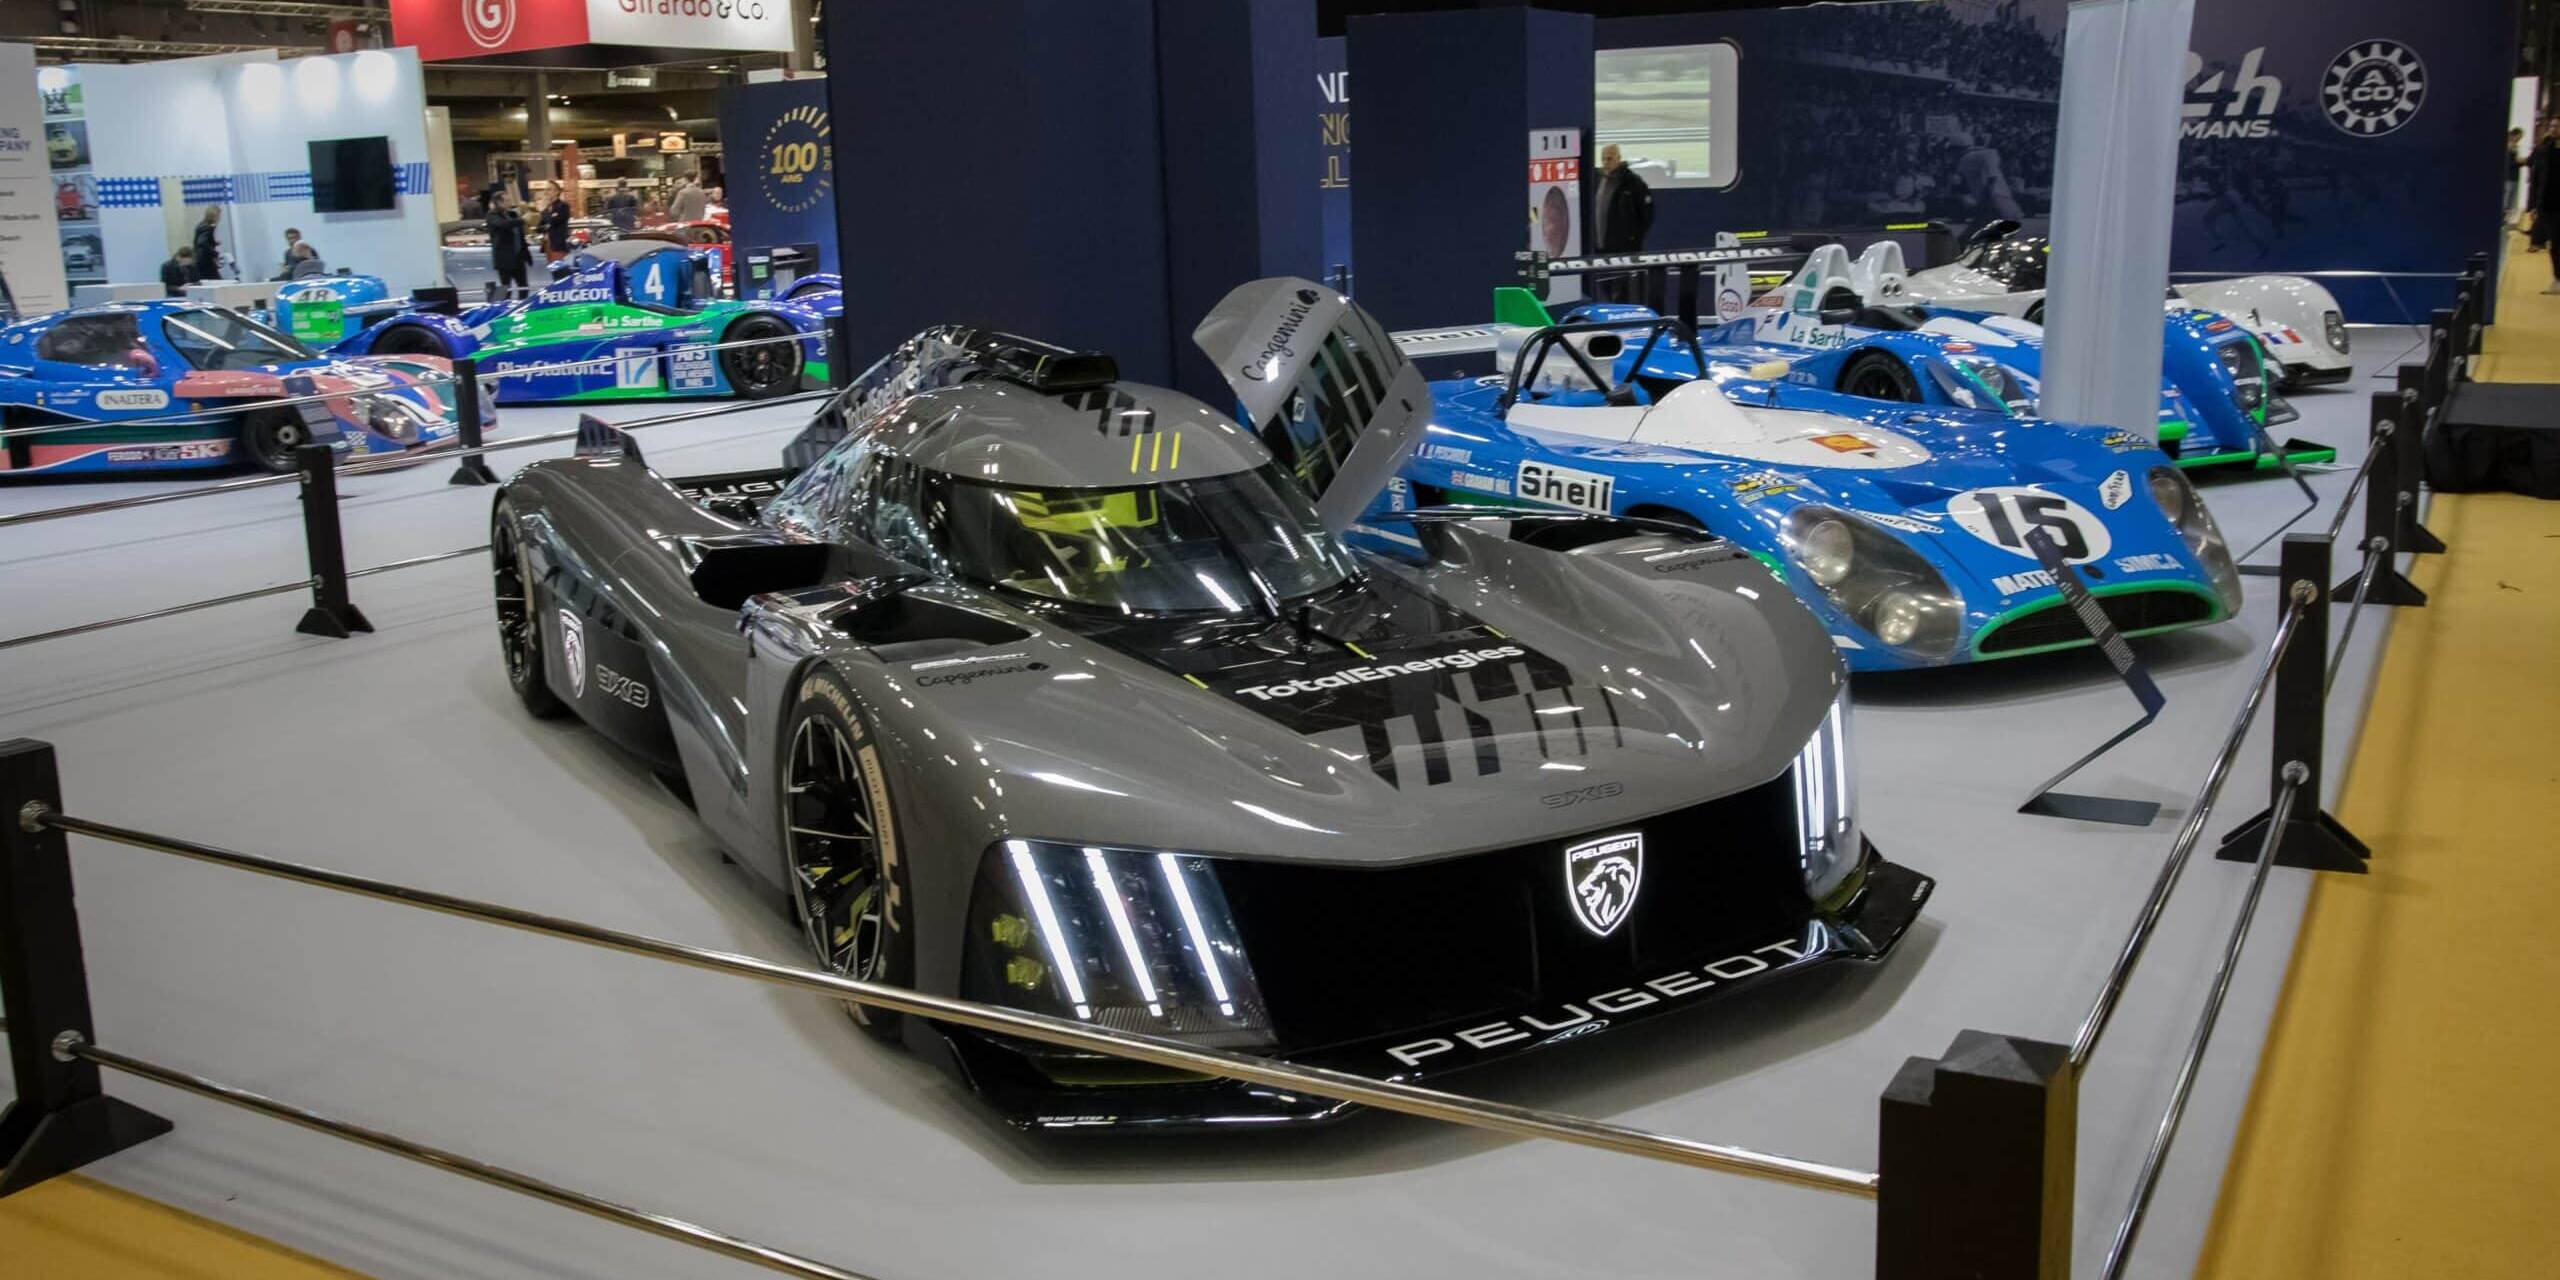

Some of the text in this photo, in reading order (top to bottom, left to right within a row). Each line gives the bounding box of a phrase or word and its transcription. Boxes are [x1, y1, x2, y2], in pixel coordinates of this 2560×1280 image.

[771, 142, 818, 174] 100
[539, 287, 612, 304] PEUGEOT
[645, 263, 664, 301] 4
[1241, 302, 1312, 381] Capgemini
[1973, 493, 2089, 559] 15
[1991, 567, 2060, 596] MATR
[916, 665, 1027, 687] Capgemini
[1235, 646, 1525, 700] TotalEnergies
[814, 677, 865, 742] MICHELIN
[1571, 839, 1638, 862] PEUGEOT
[1386, 938, 1804, 1067] PEUGEOT
